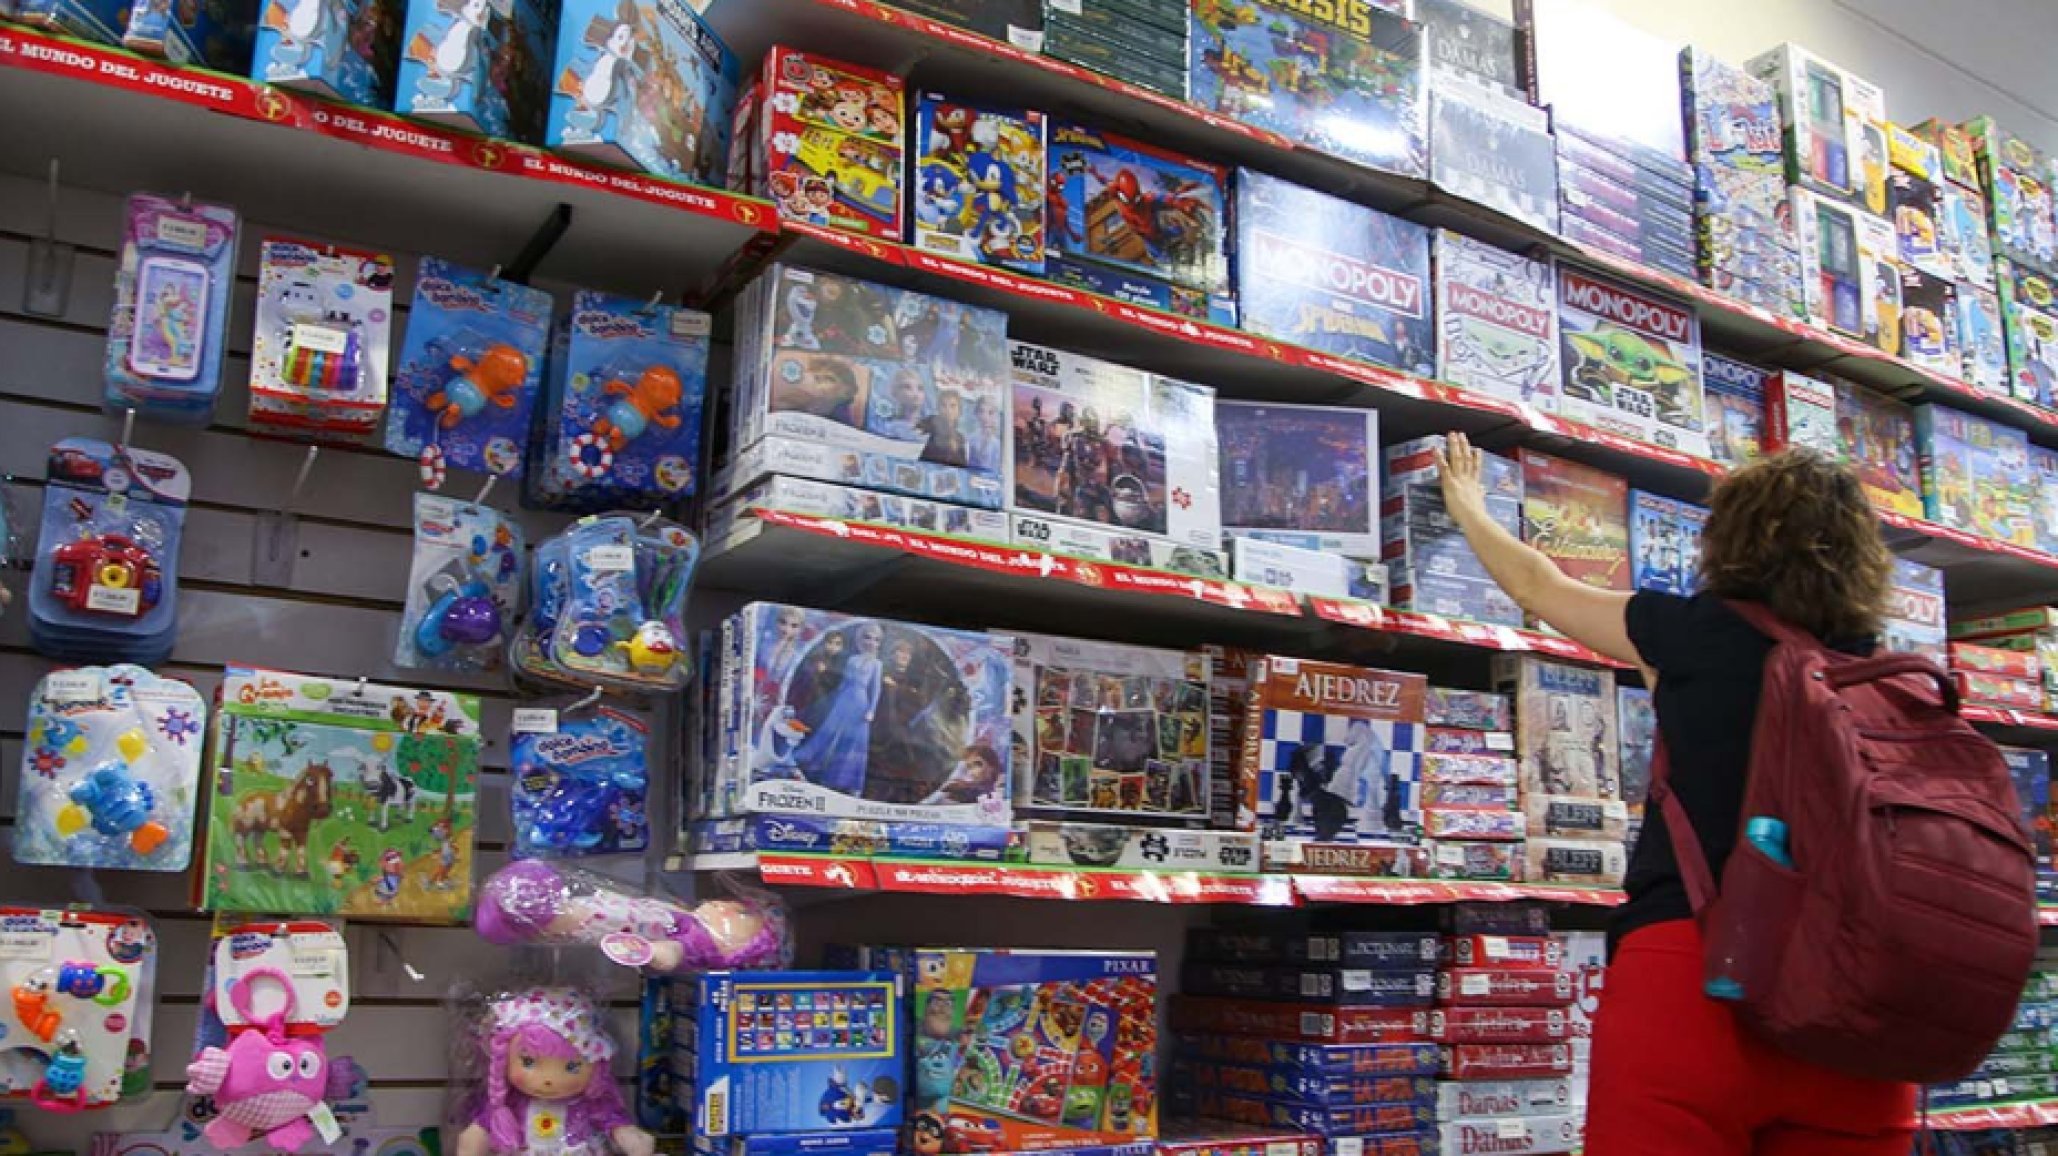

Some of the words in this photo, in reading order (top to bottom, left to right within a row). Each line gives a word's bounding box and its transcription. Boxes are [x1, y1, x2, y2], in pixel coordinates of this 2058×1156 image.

[1438, 38, 1498, 77] DAMAS
[20, 43, 95, 70] MUNDO
[100, 60, 140, 81] DEL
[144, 71, 233, 101] JUGUETE
[333, 114, 368, 133] DEL
[371, 124, 453, 152] JUGUETE
[523, 157, 544, 170] EL
[549, 163, 607, 184] MUNDO
[610, 176, 641, 192] DEL
[644, 185, 717, 210] JUGUETE
[1258, 235, 1418, 312] MONOPOLY
[1451, 288, 1548, 335] MONOPOLY
[1567, 279, 1688, 340] MONOPOLY
[1012, 344, 1058, 365] STAR
[1013, 357, 1060, 376] WARS
[1615, 387, 1653, 405] STAR
[1615, 399, 1652, 417] WARS
[1294, 672, 1402, 707] AJEDREZ
[538, 738, 575, 754] dolce
[552, 741, 608, 762] bambino
[757, 791, 814, 811] FROZEN
[763, 820, 820, 849] Disney
[1103, 960, 1150, 974] PIXAR
[1458, 1091, 1521, 1116] Damas
